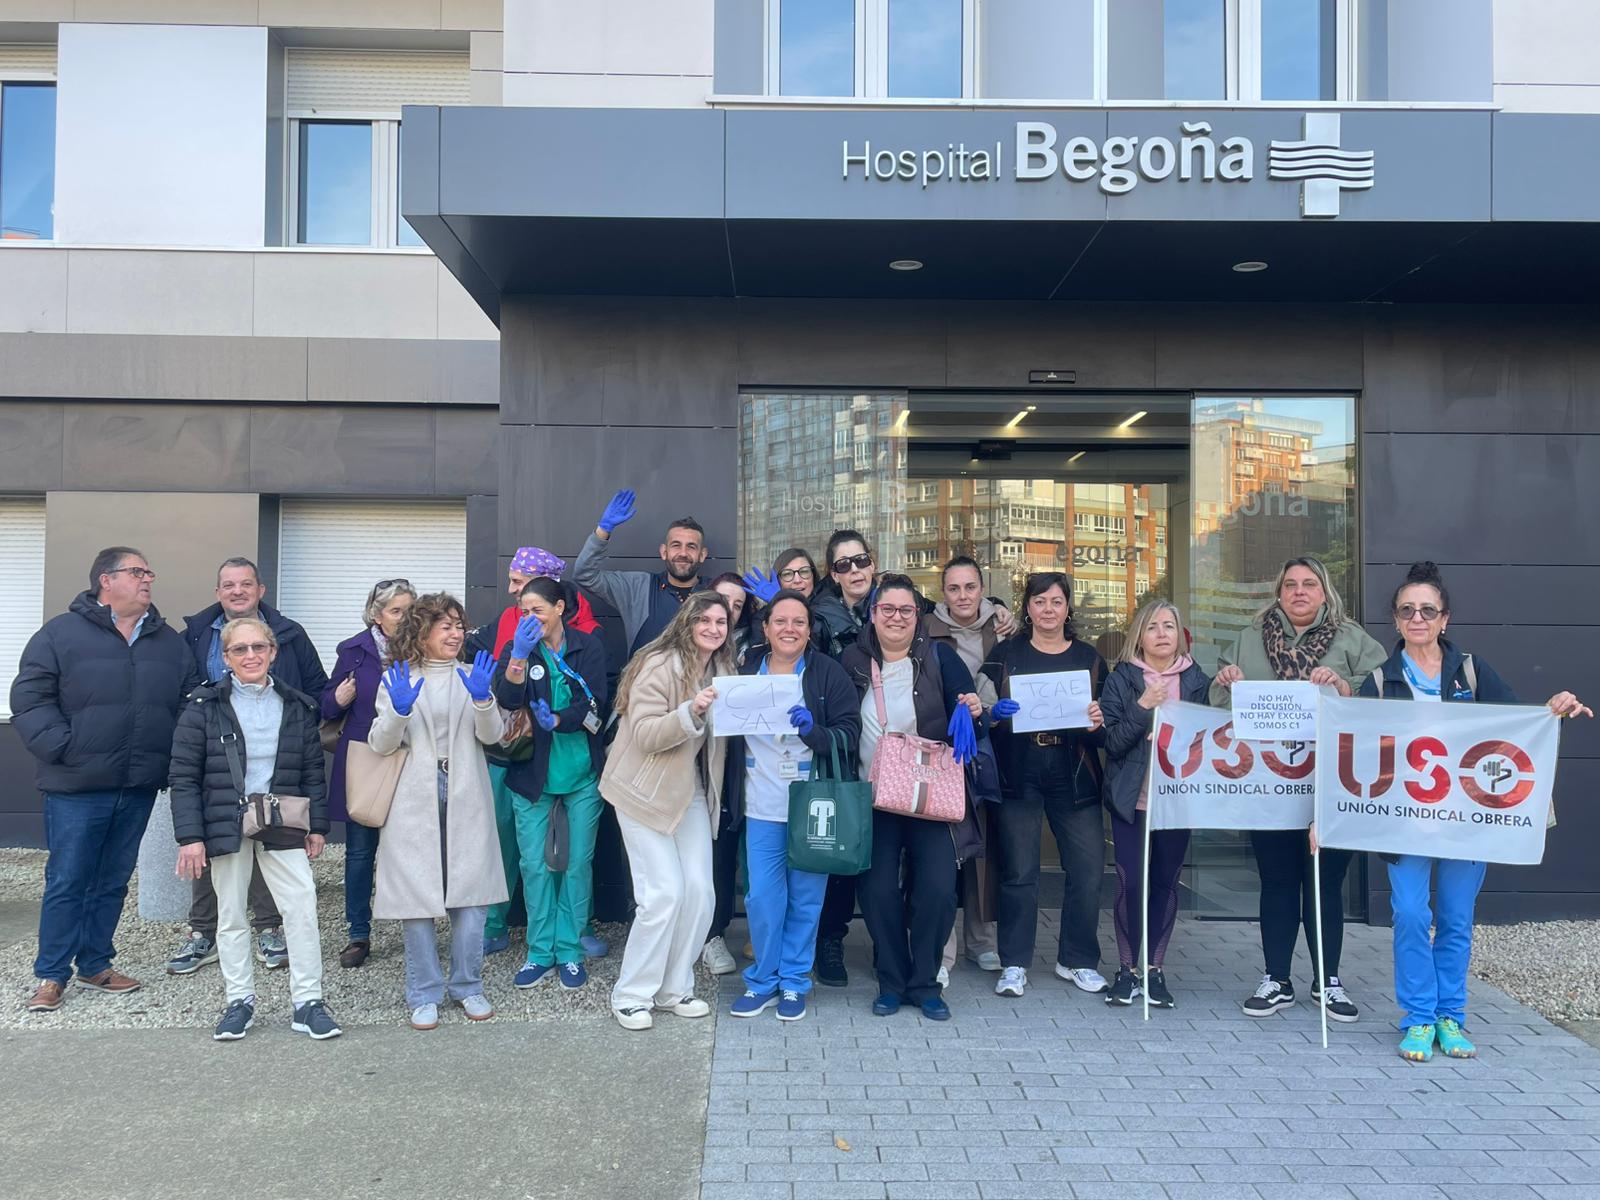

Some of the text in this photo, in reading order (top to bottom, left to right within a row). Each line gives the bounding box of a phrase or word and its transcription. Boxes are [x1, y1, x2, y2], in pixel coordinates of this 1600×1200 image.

[842, 121, 1254, 194] Hospital Begoña
[1020, 679, 1082, 697] TCAE
[1258, 694, 1294, 702] NO HAY
[1240, 712, 1313, 720] NO HAY EXCUSA
[1253, 721, 1300, 730] SOMOS C1
[1338, 732, 1536, 809] USO
[1158, 781, 1200, 795] UNIÓN
[1205, 783, 1270, 795] SINDICAL
[1337, 800, 1533, 828] UNIÓN SINDICAL OBRERA
